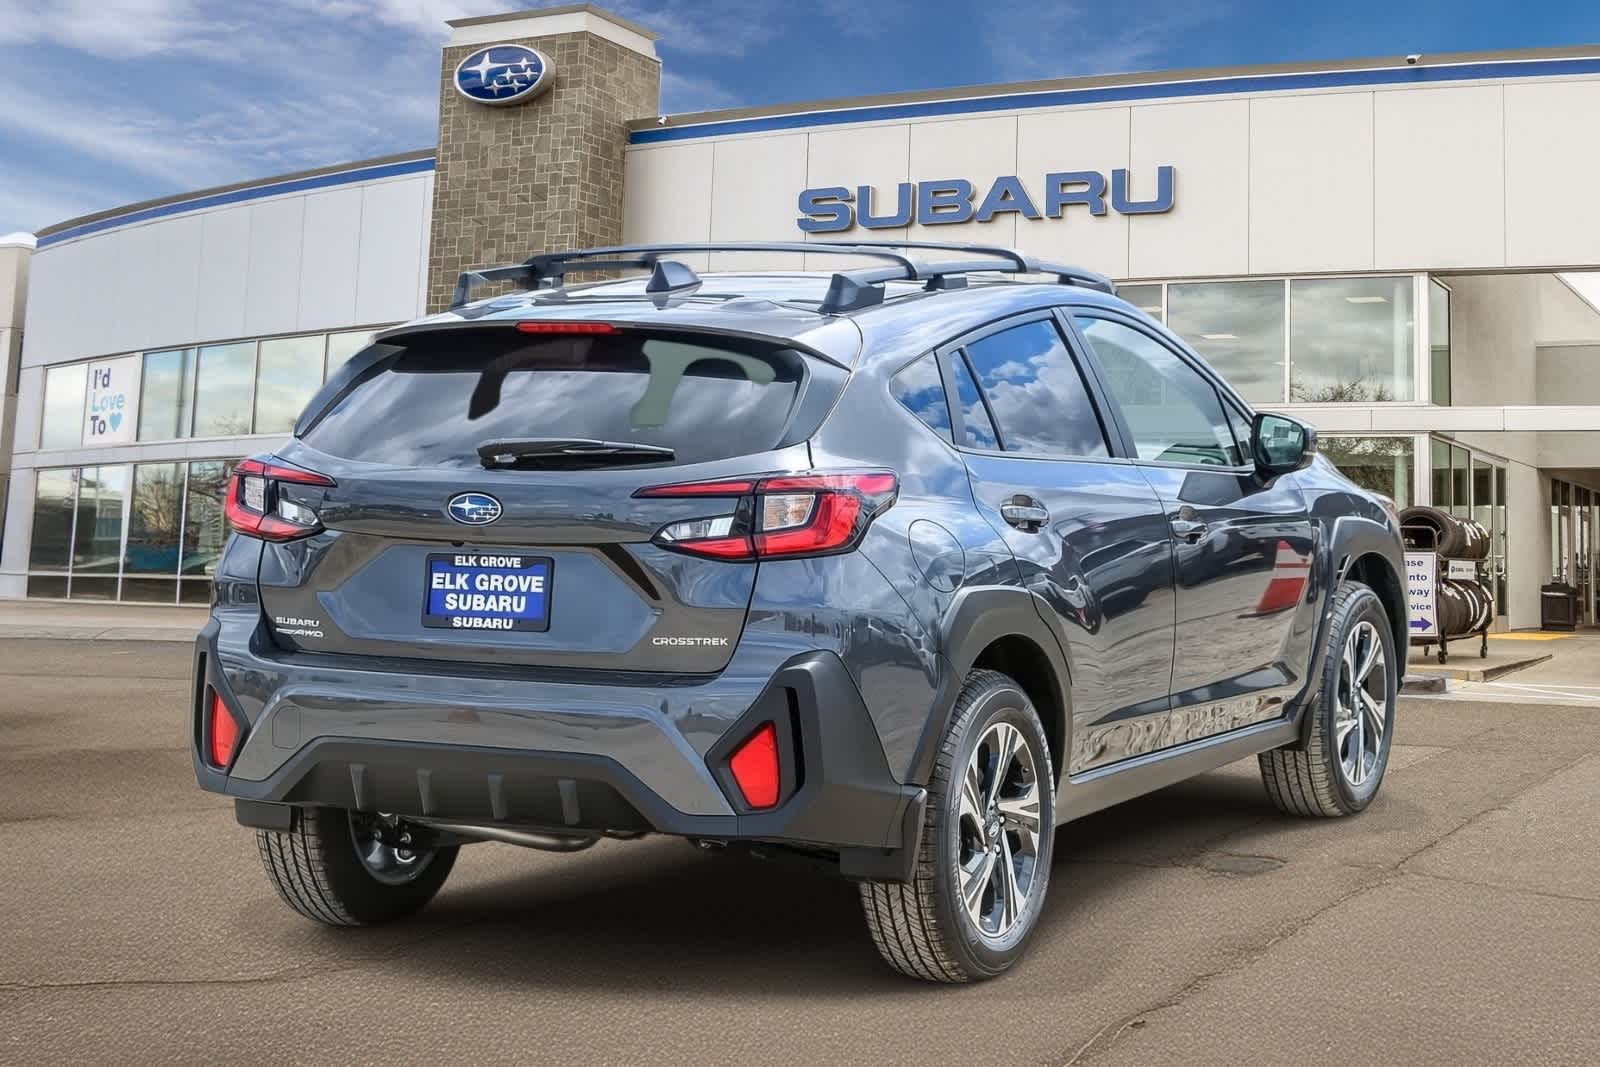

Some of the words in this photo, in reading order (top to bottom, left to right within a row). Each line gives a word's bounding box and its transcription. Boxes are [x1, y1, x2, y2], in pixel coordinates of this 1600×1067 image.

[797, 165, 1175, 233] SUBARU
[93, 367, 111, 389] I'd
[91, 392, 125, 412] Love
[90, 415, 106, 435] To
[454, 555, 477, 567] ELK
[480, 556, 521, 568] GROVE
[432, 572, 469, 591] ELK
[475, 573, 544, 593] GROVE
[1409, 573, 1428, 581] nto
[1408, 589, 1430, 598] way
[445, 593, 526, 613] SUBARU
[275, 616, 320, 627] SUBARU
[452, 616, 513, 629] SUBARU
[652, 637, 729, 646] CROSSTREK
